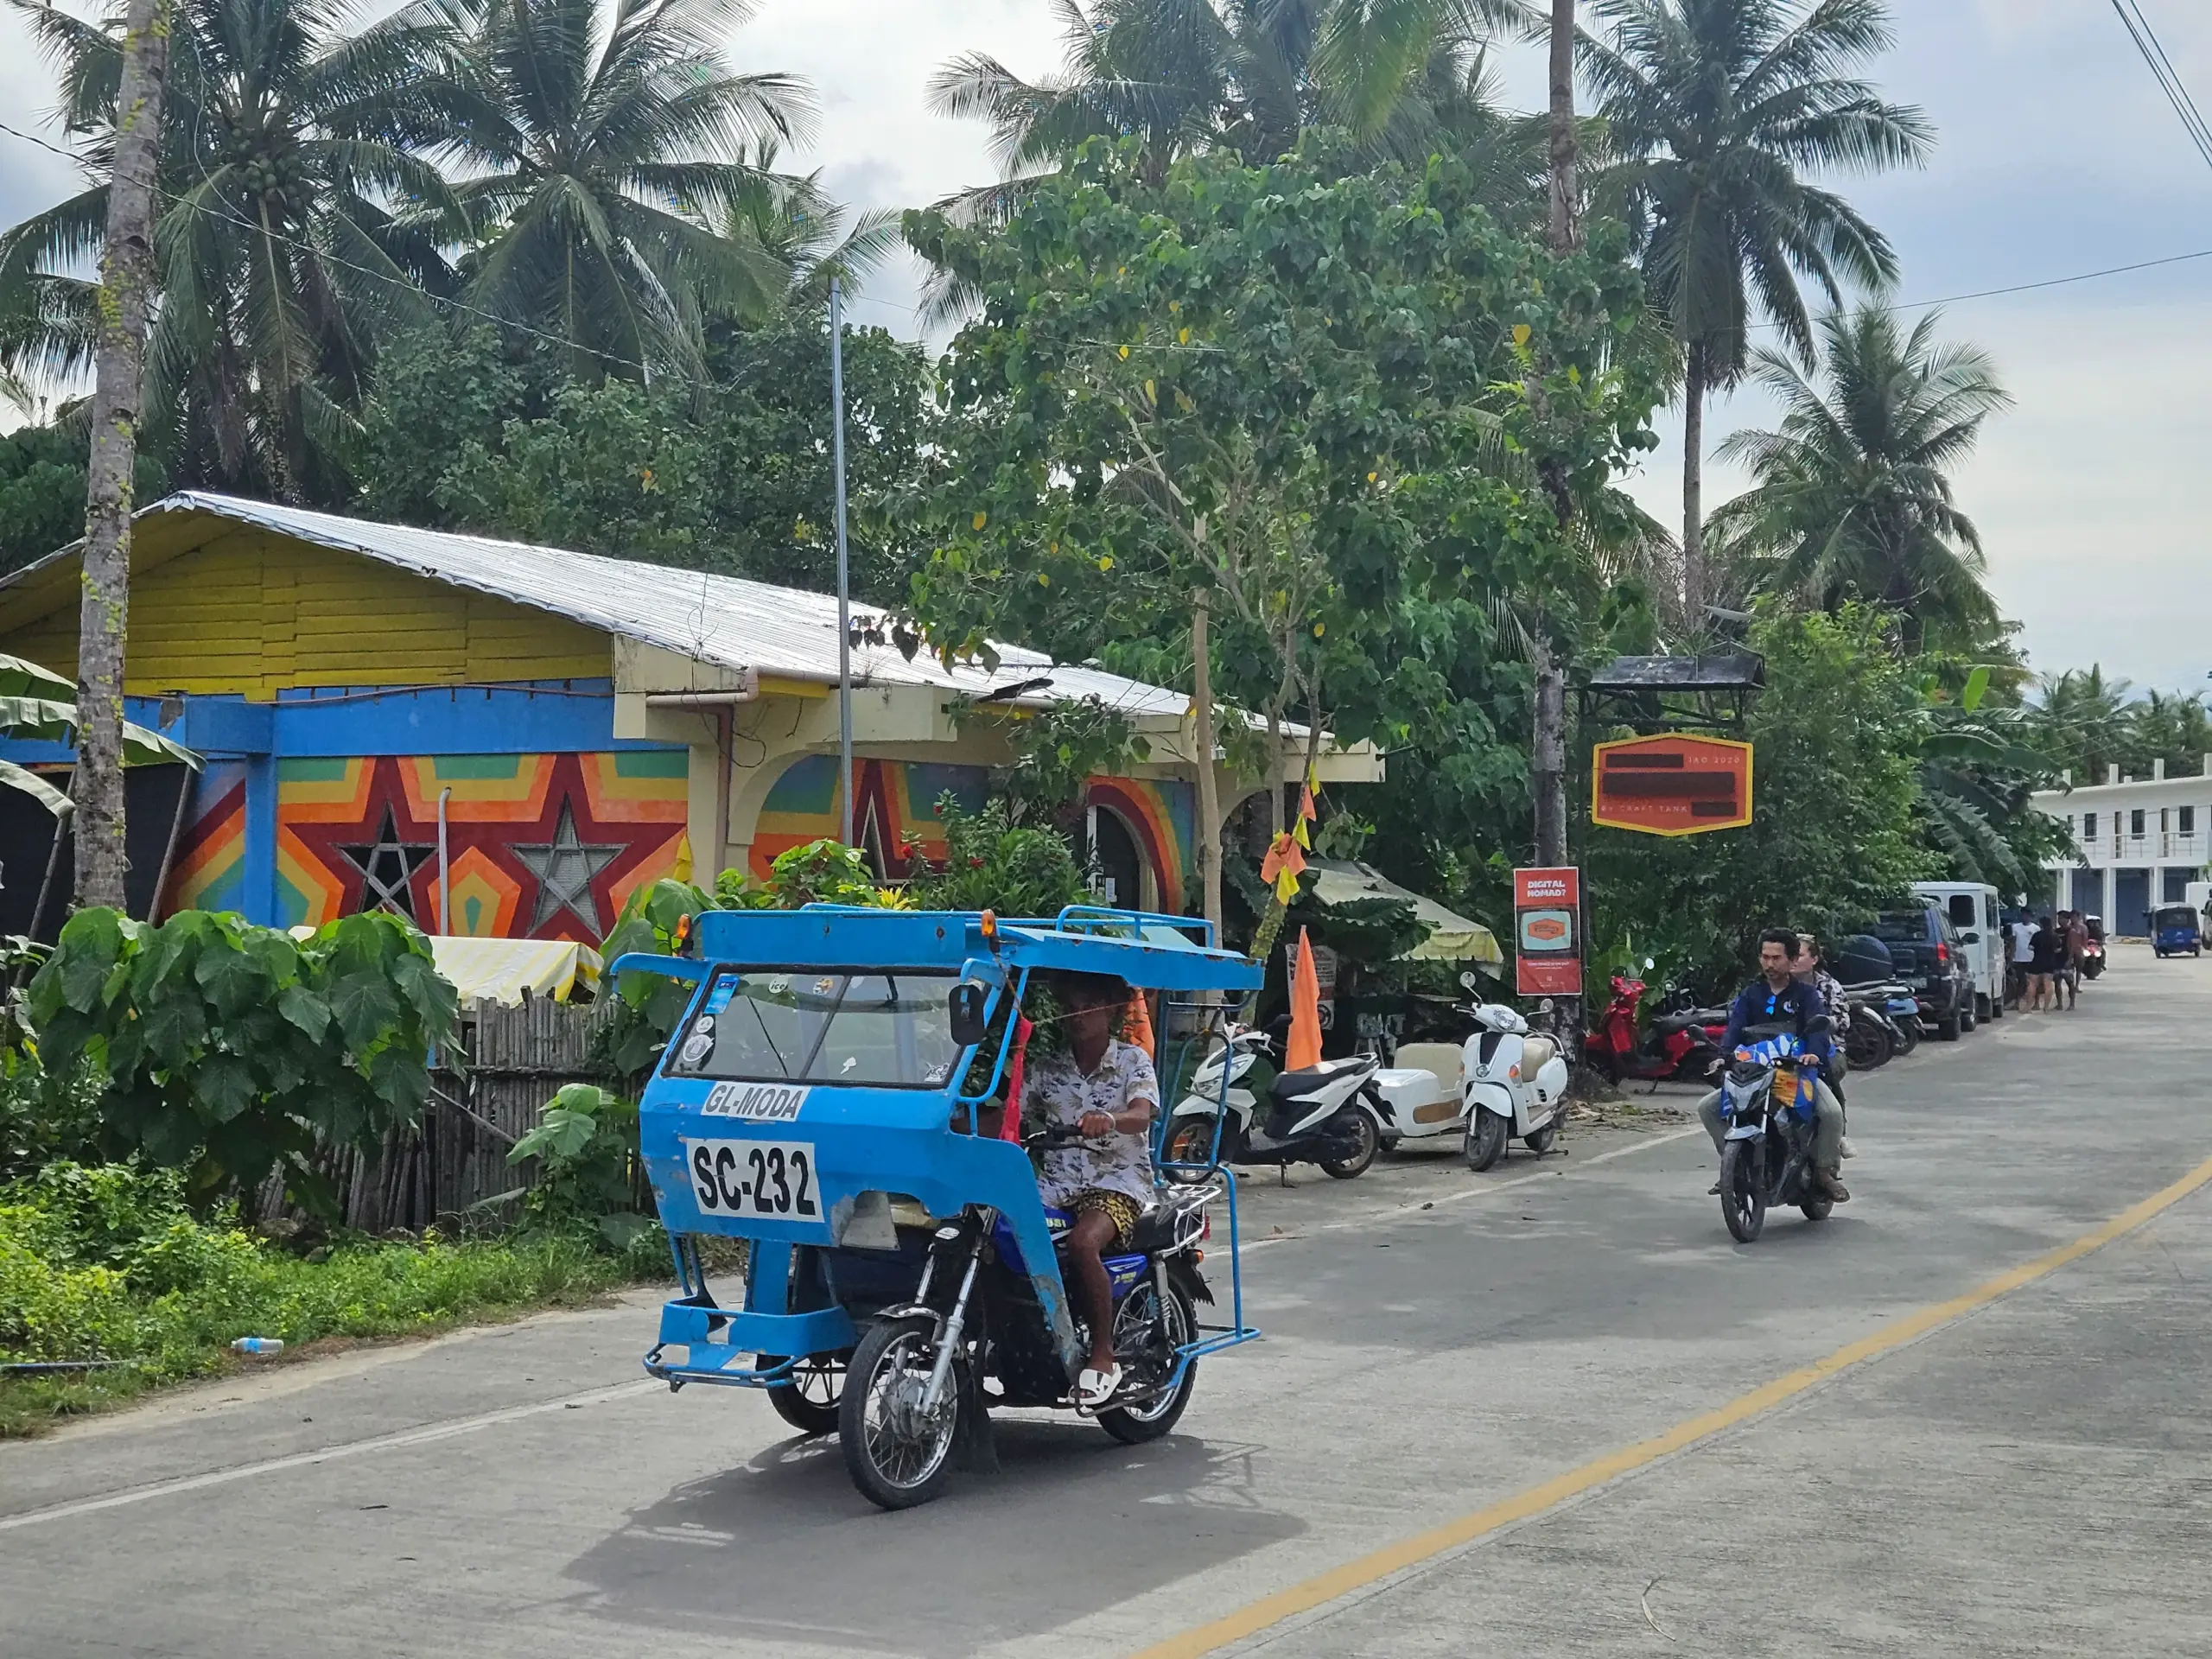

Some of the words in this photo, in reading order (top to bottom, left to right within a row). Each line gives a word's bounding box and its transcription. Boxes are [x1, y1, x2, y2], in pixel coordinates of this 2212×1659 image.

[1527, 880, 1566, 888] DIGITAL
[1527, 889, 1567, 898] NOMAD?
[705, 1084, 803, 1119] GL-MODA
[694, 1146, 816, 1217] SC-232
[1045, 1217, 1066, 1228] USI
